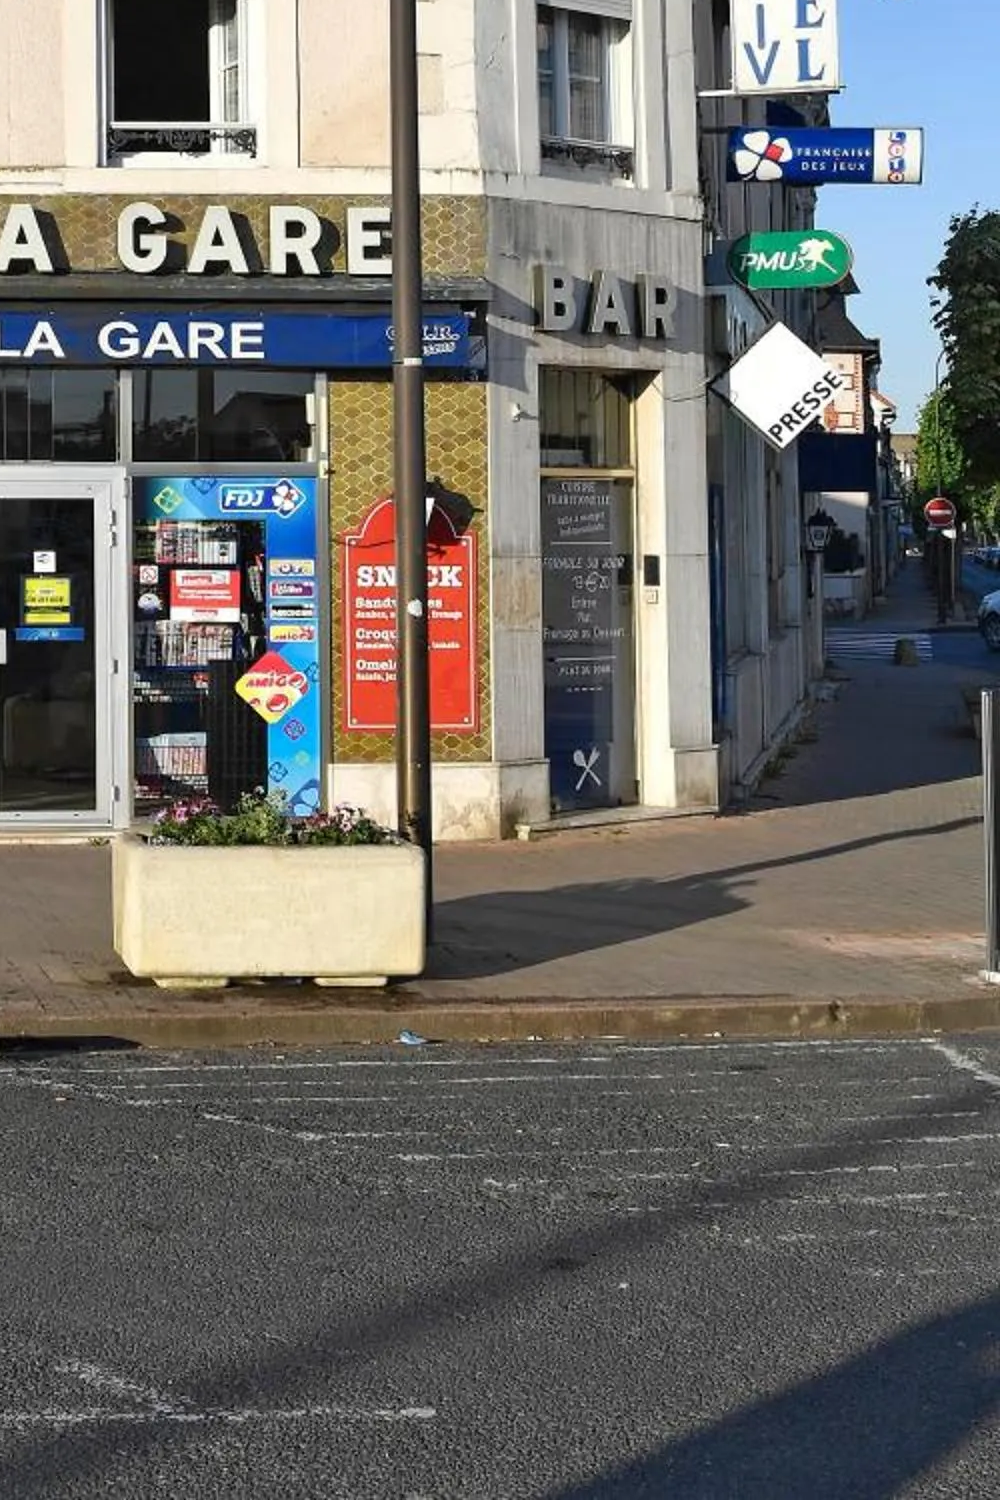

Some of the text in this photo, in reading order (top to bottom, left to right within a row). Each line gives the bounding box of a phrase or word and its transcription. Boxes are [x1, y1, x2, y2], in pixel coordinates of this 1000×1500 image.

[801, 161, 866, 173] DES JEUX
[888, 131, 907, 183] LOTO
[117, 202, 393, 275] GARE
[741, 250, 797, 273] PMU
[536, 266, 678, 338] BAR
[98, 319, 265, 360] GARE
[767, 370, 843, 443] PRESSE
[223, 487, 264, 508] FDJ
[356, 565, 463, 587] SNCK
